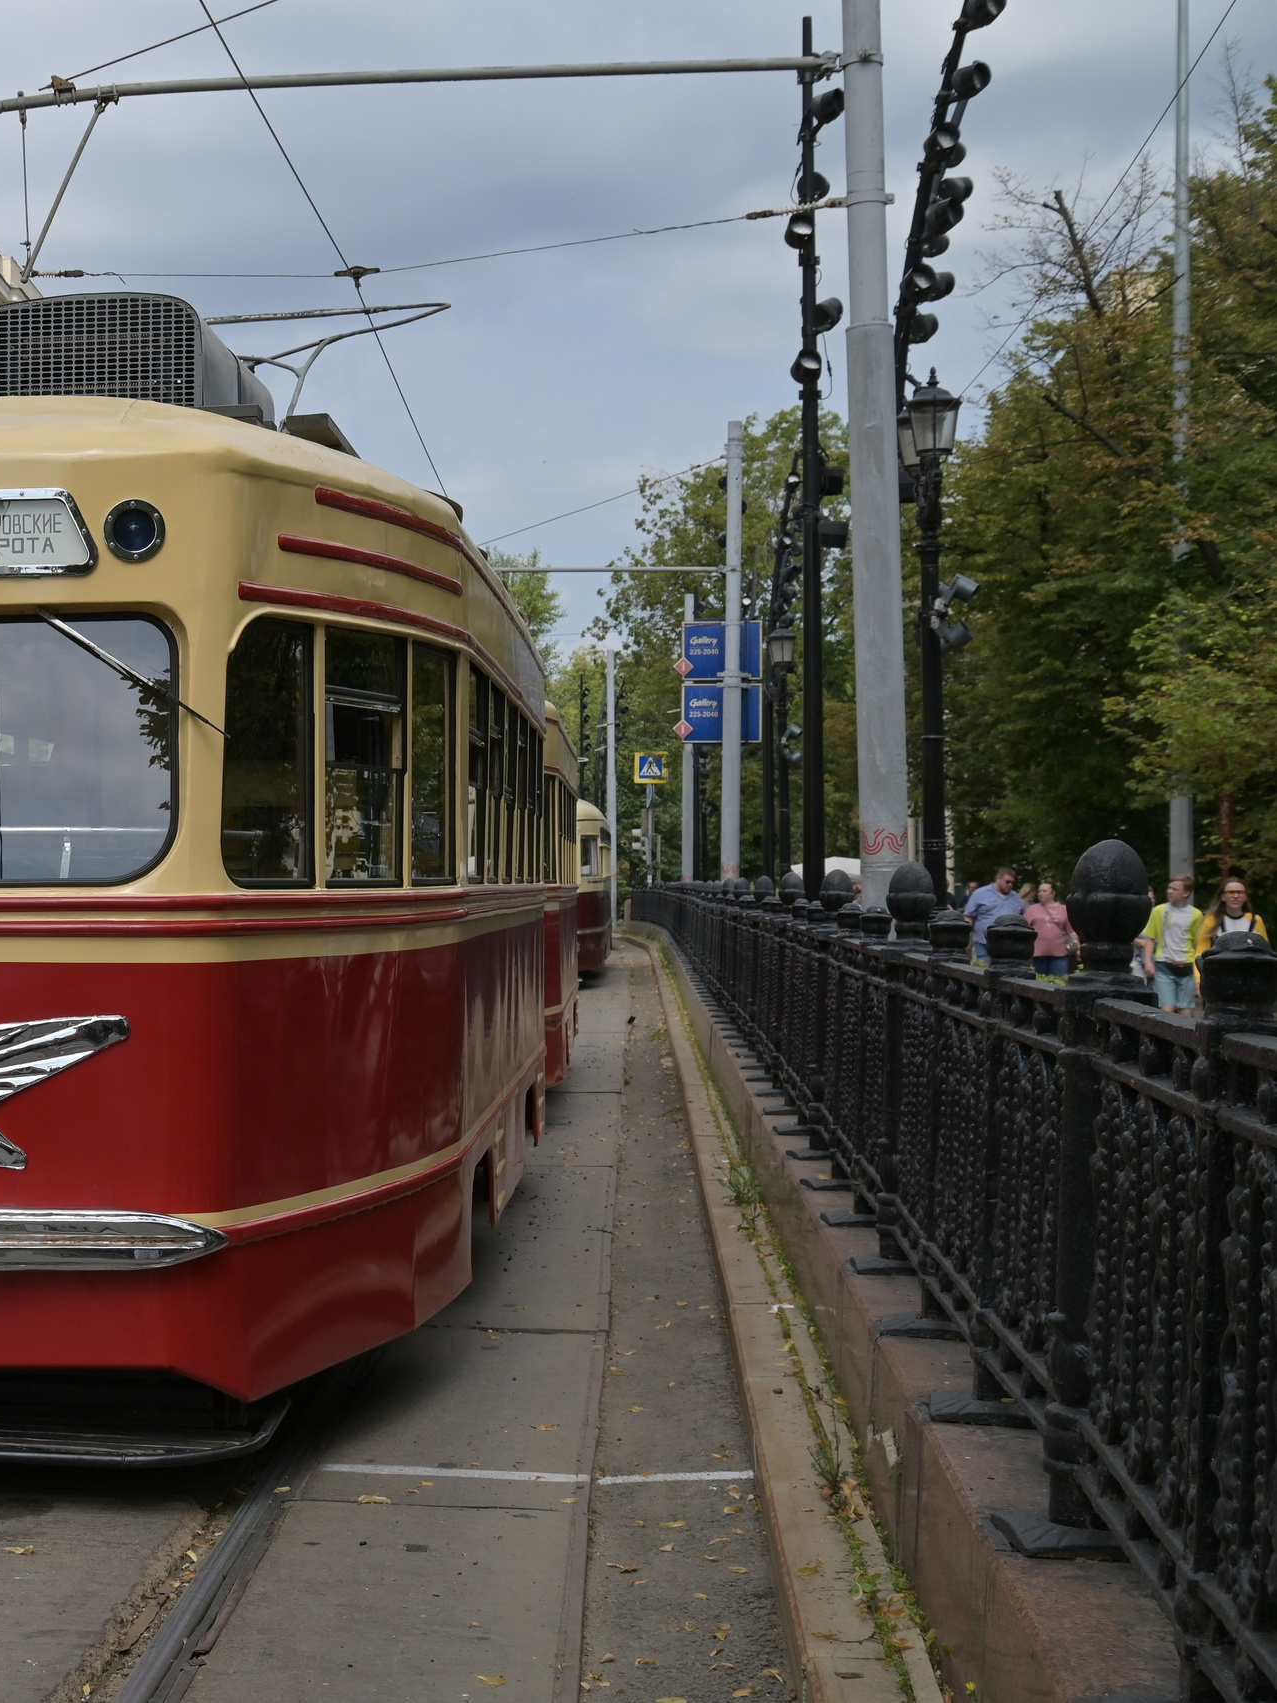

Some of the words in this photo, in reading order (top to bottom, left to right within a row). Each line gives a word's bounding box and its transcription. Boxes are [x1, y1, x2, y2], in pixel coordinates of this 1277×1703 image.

[689, 635, 719, 647] Gallery
[689, 648, 719, 656] 225-2040
[689, 698, 718, 710] Gallery
[689, 710, 719, 718] 225-2040
